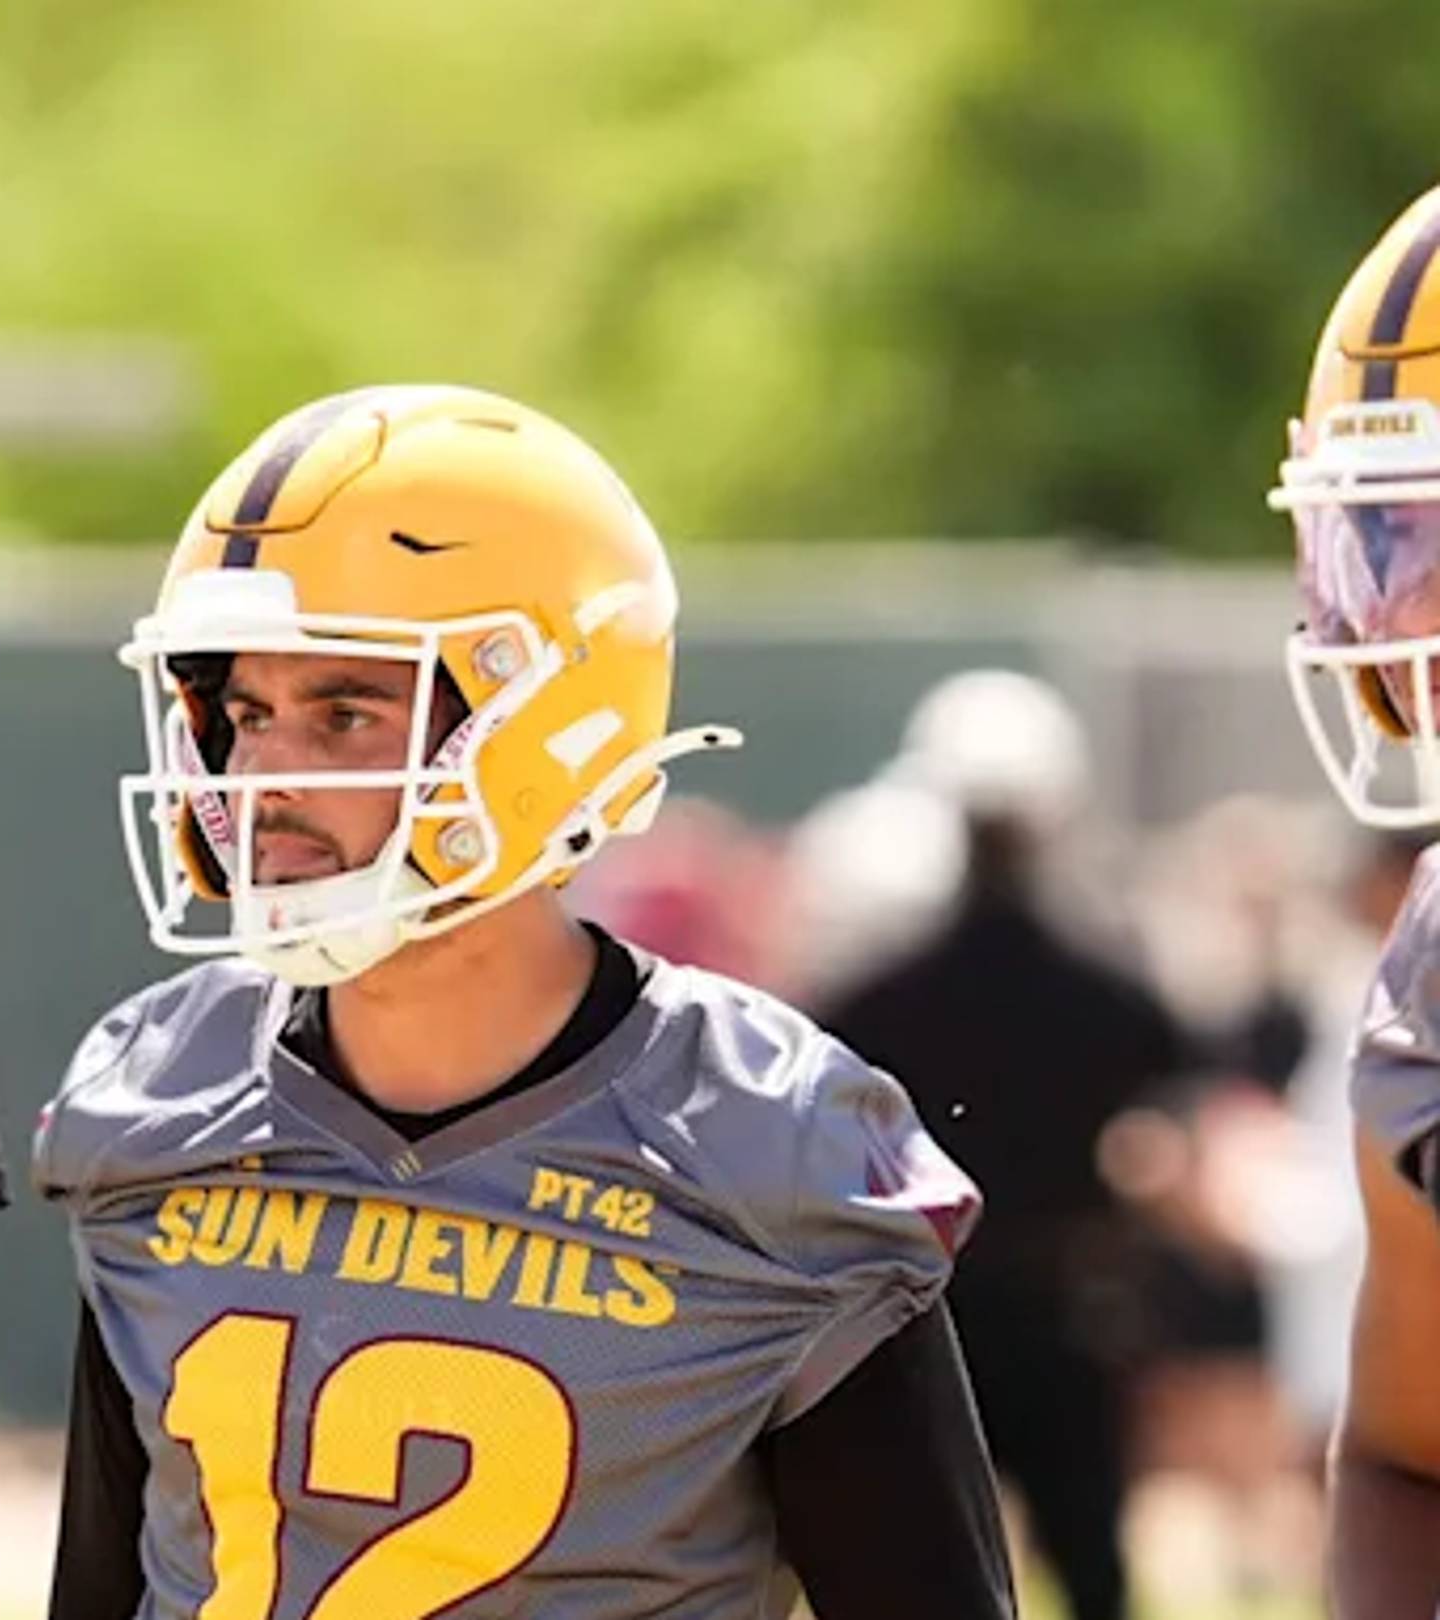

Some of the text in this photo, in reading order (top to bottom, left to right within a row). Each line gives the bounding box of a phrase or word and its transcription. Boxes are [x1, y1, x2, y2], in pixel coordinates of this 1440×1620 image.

[147, 1186, 679, 1328] SUN DEVILS
[527, 1168, 656, 1238] PT 42
[160, 1308, 578, 1620] 12
